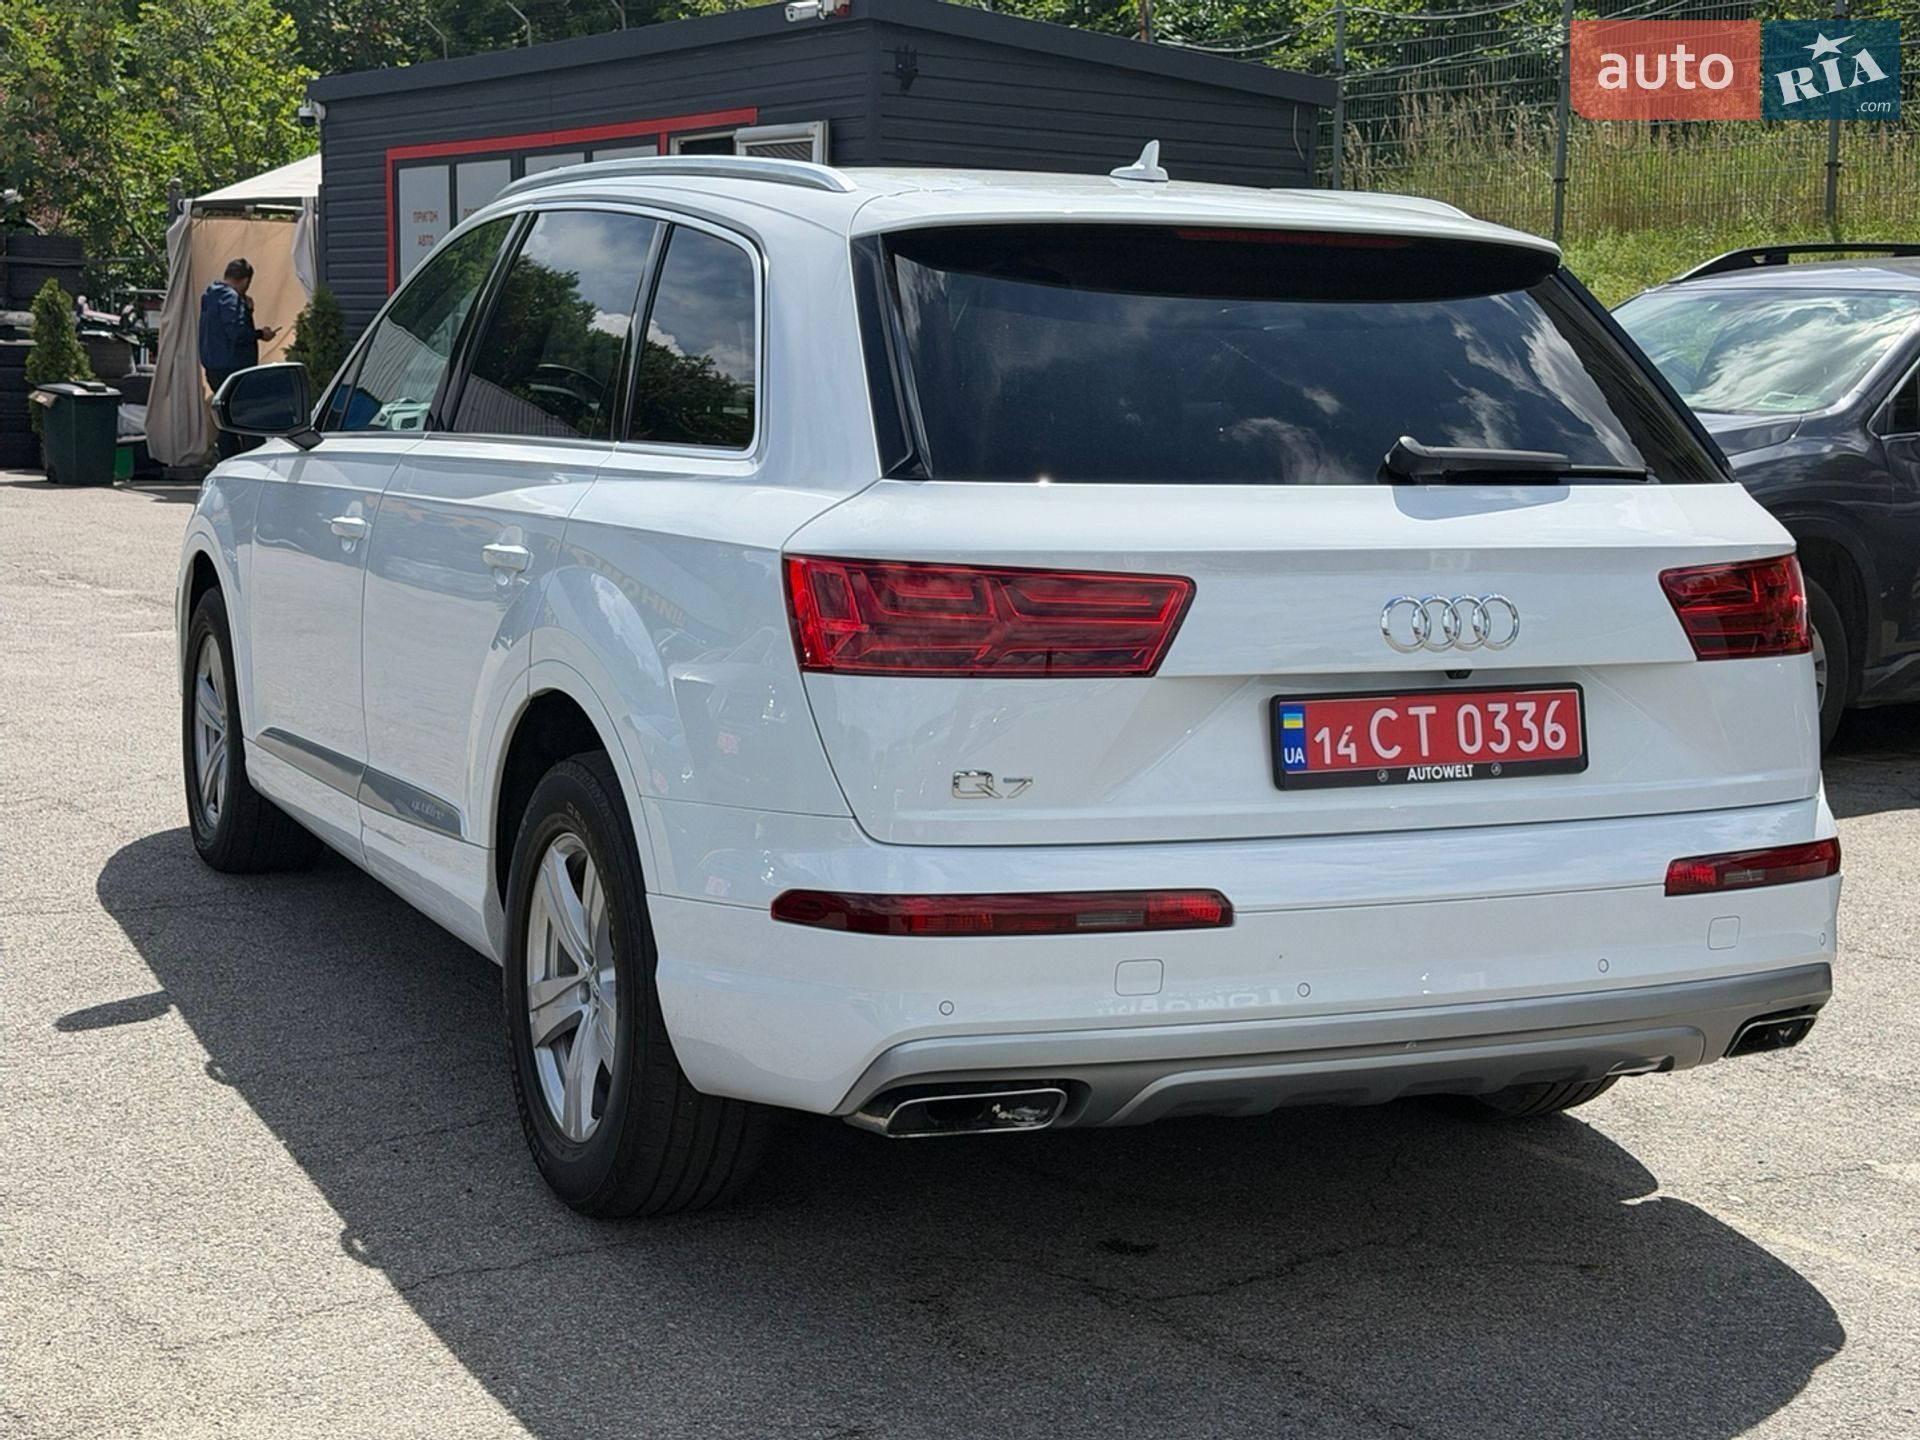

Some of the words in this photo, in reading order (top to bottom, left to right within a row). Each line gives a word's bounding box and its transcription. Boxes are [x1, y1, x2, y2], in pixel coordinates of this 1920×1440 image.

[1314, 727, 1357, 764] 14
[1369, 707, 1437, 759] CT
[1457, 700, 1567, 755] 0336
[1284, 747, 1305, 763] UA
[1407, 764, 1474, 781] AUTOWELT
[952, 770, 1034, 799] Q7
